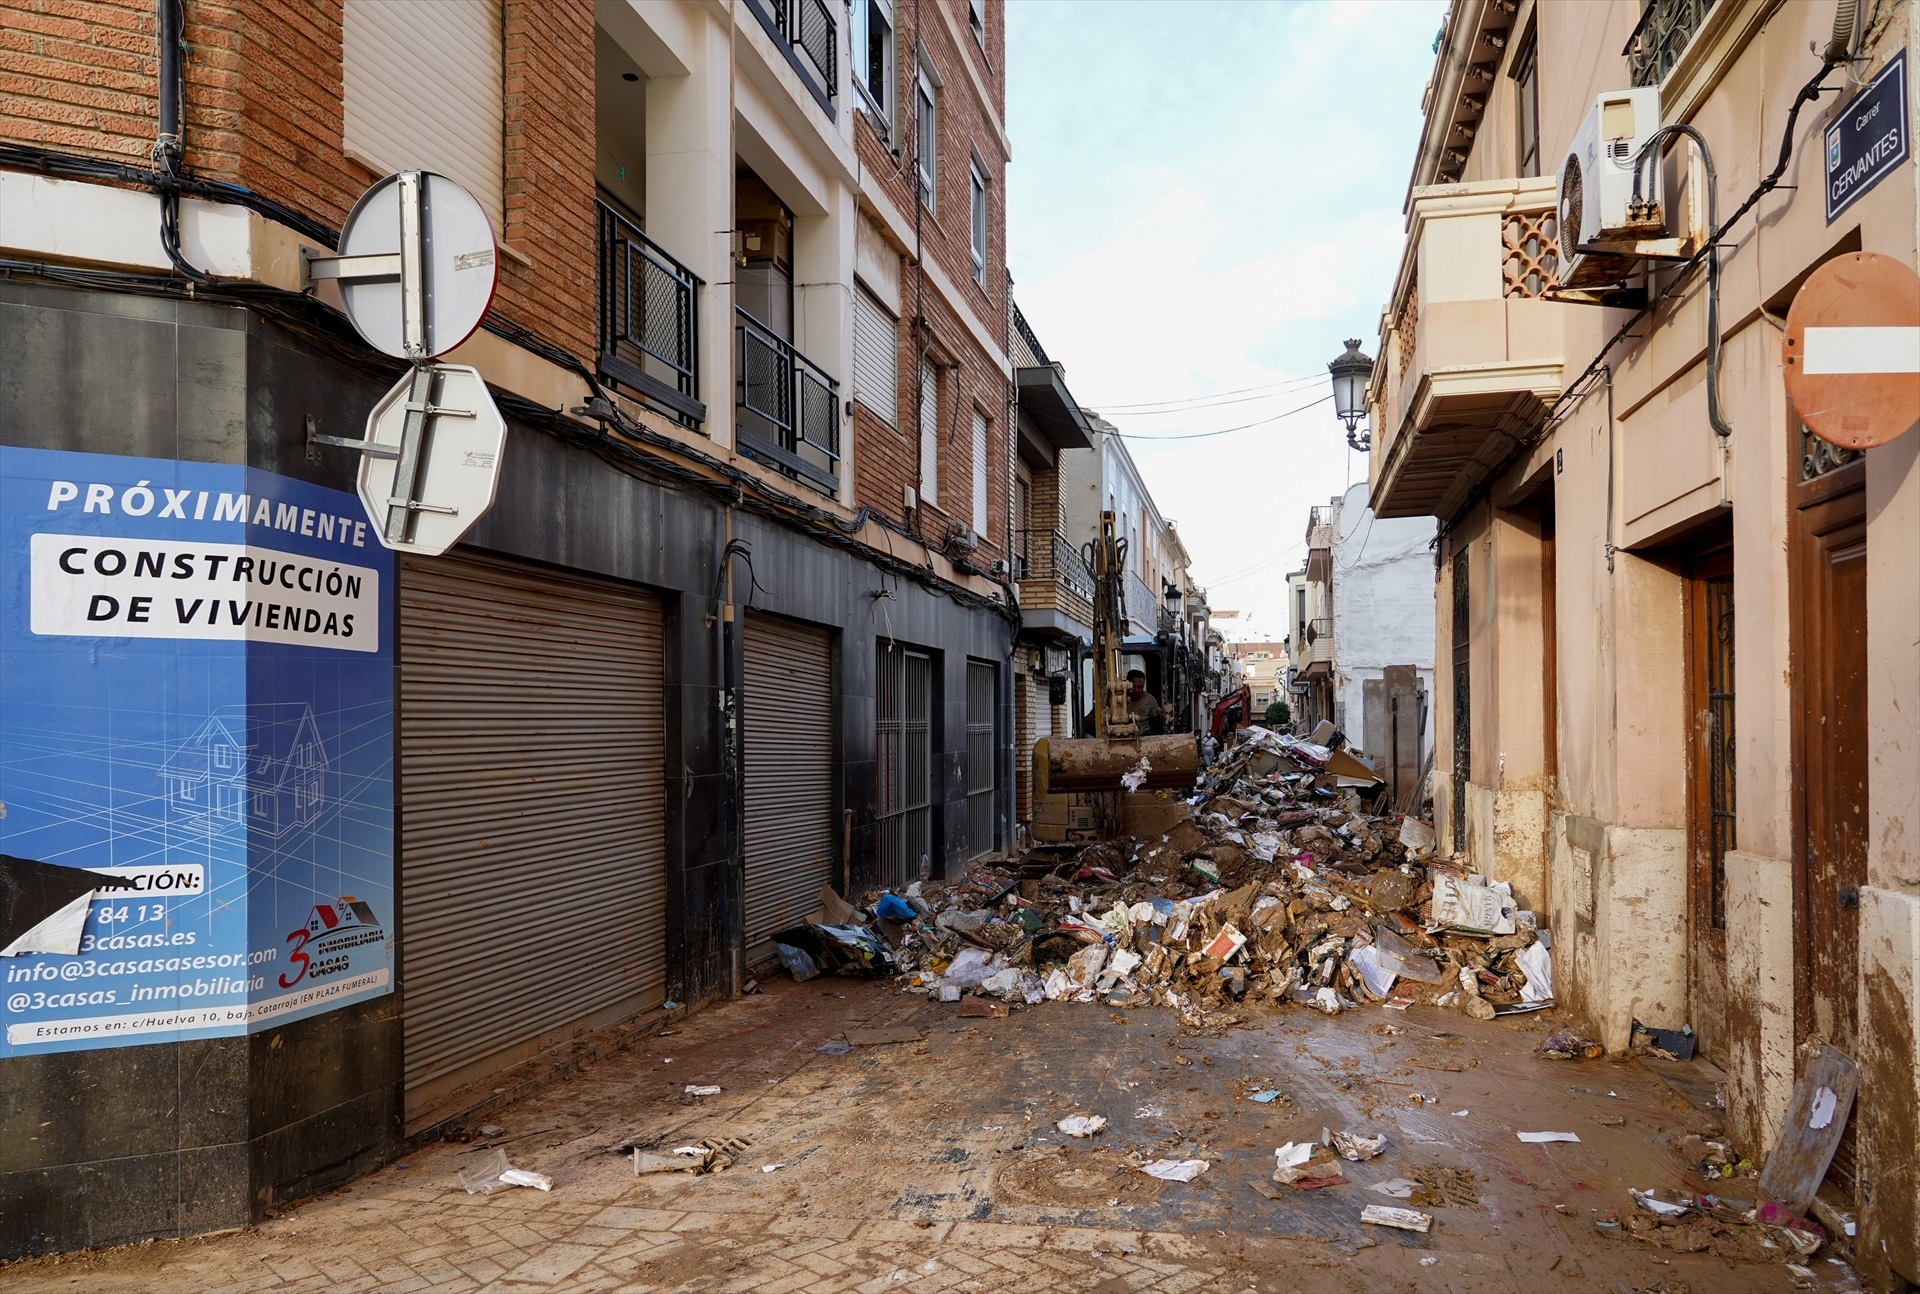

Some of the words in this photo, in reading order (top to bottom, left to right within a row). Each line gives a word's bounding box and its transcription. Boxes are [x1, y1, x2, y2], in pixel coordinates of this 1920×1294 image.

[1856, 101, 1881, 132] Carrer
[1832, 128, 1898, 201] CERVANTES
[47, 480, 367, 548] PRÓXIMAMENTE
[59, 547, 362, 599] CONSTRUCCIÓN
[87, 595, 153, 623] DE
[175, 598, 354, 638] VIVIENDAS
[98, 906, 129, 924] 84
[138, 904, 165, 921] 13
[7, 947, 277, 983] info@3casasasesor.com
[278, 929, 311, 989] 3
[318, 929, 385, 955] INMOBILIARIA
[309, 955, 349, 978] CASAS
[7, 975, 265, 1013] @3casas_inmobiliaria
[36, 1025, 99, 1037] Estamos
[105, 1021, 127, 1030] en:
[132, 1015, 196, 1029] c/Huelva
[202, 1012, 221, 1023] 10,
[258, 997, 299, 1015] Catarroja
[300, 993, 314, 1005] (EN
[316, 985, 340, 999] PLAZA
[342, 975, 378, 992] FUMERAL)
